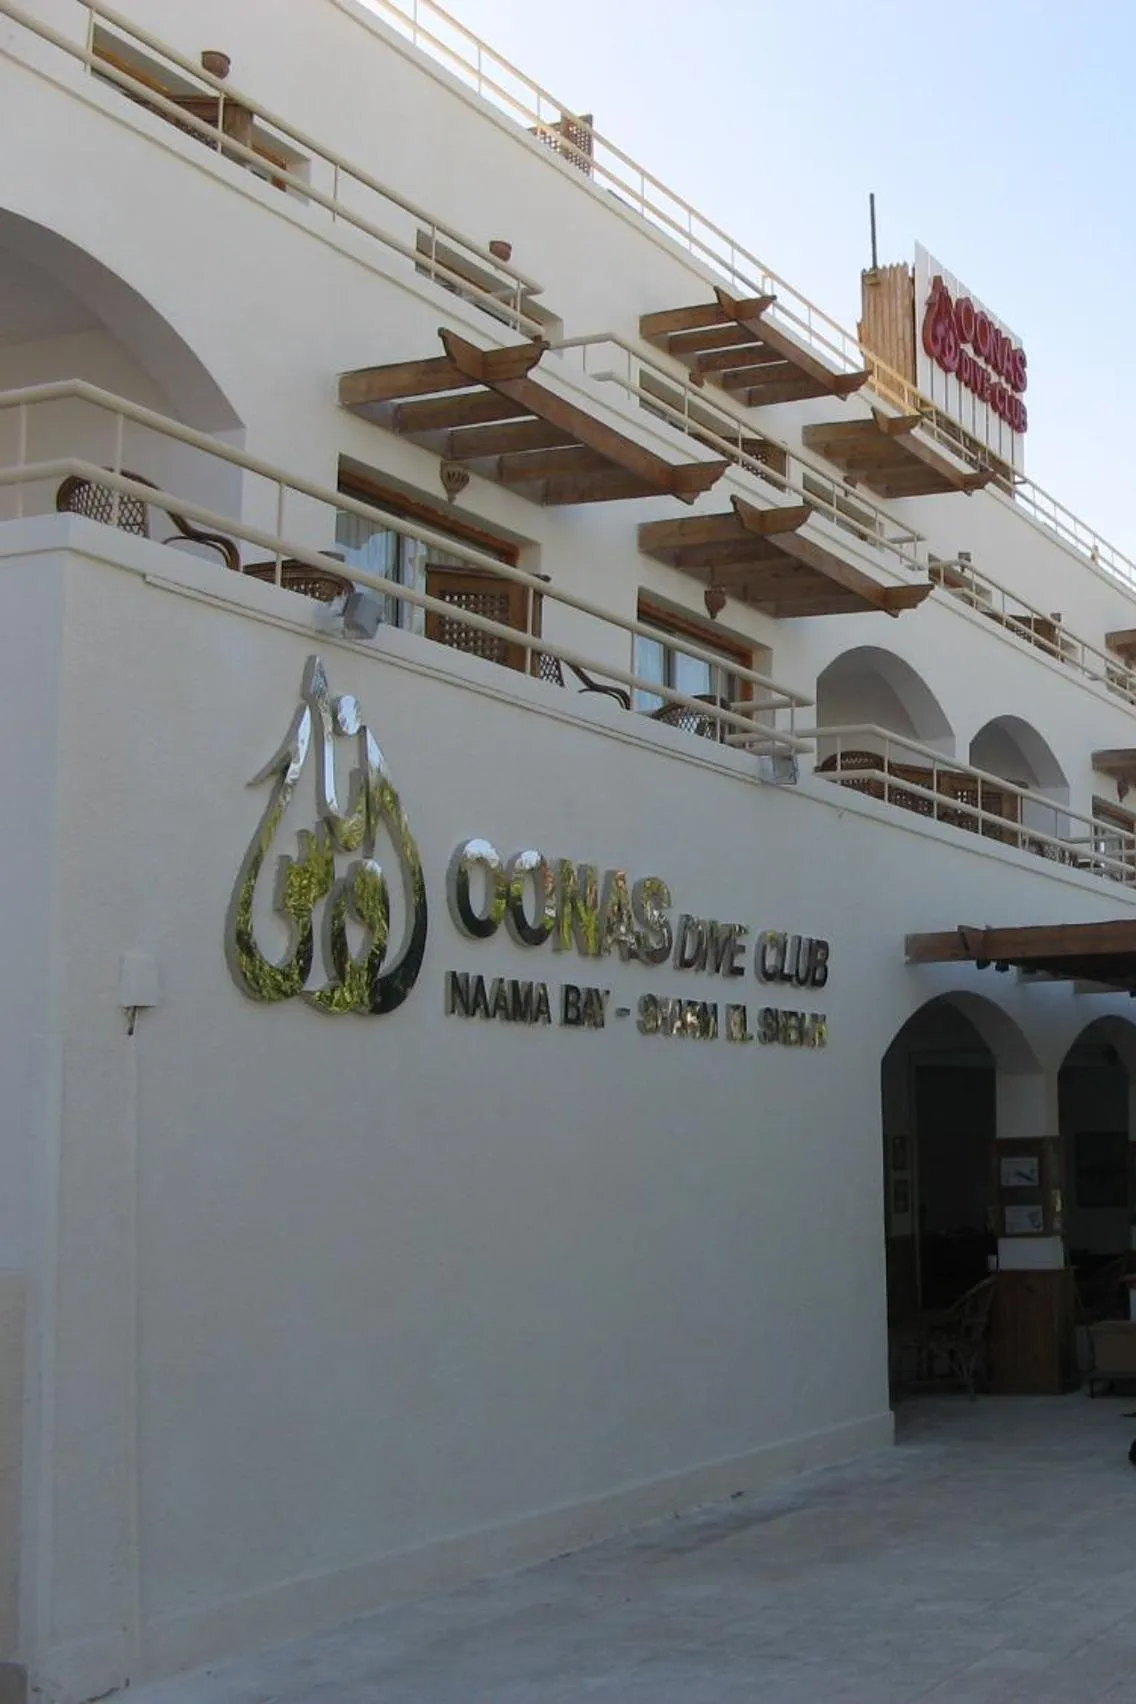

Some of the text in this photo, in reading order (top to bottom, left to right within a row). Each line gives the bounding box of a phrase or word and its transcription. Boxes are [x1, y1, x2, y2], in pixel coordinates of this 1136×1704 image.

[954, 296, 1027, 394] OONAS
[446, 838, 830, 990] OONAS DIVE CLUB
[445, 970, 552, 1025] NAAMA
[560, 983, 611, 1029] BAY
[637, 993, 719, 1040] SHARM
